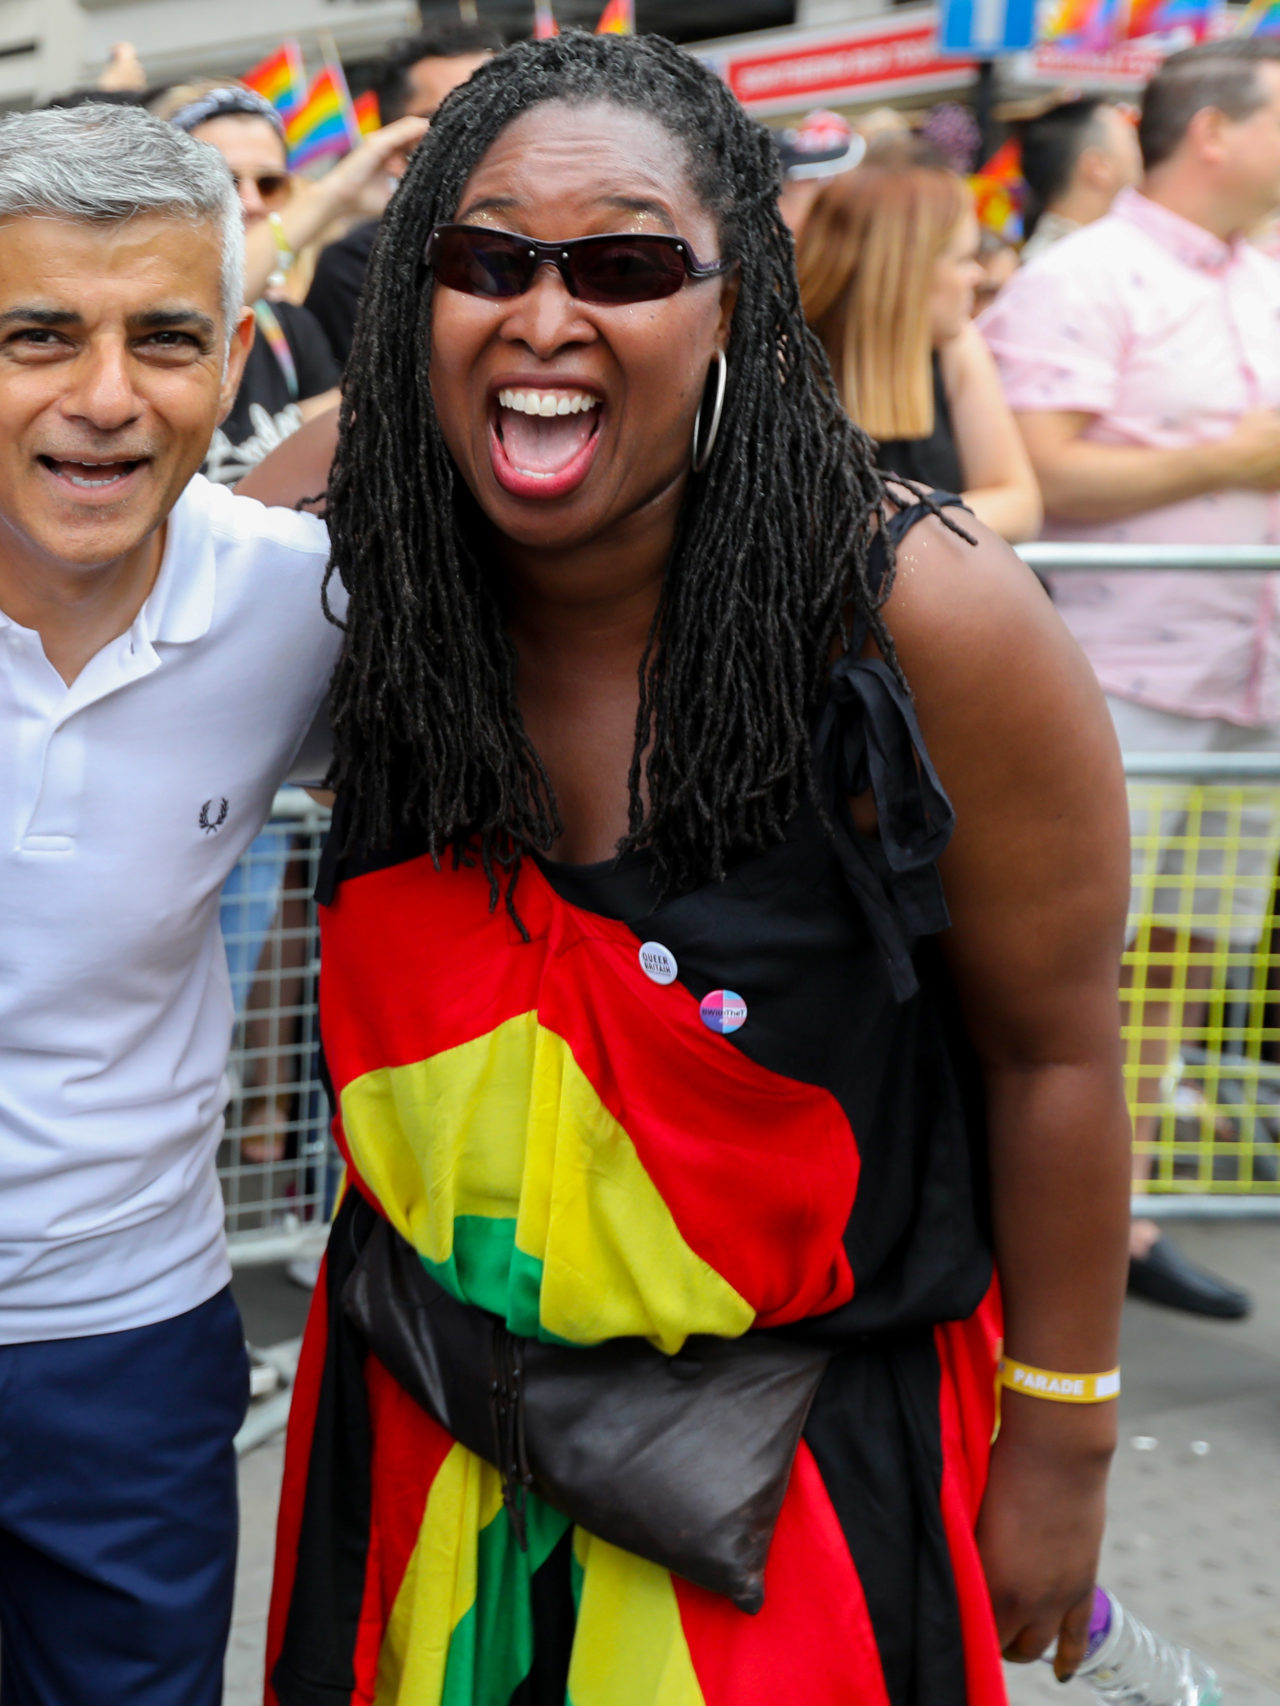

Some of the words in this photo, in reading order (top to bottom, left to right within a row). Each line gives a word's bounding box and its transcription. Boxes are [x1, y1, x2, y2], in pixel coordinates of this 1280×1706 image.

[642, 952, 668, 964] QUEER
[644, 962, 671, 974] BRITAIN
[1013, 1369, 1085, 1396] PARADE
